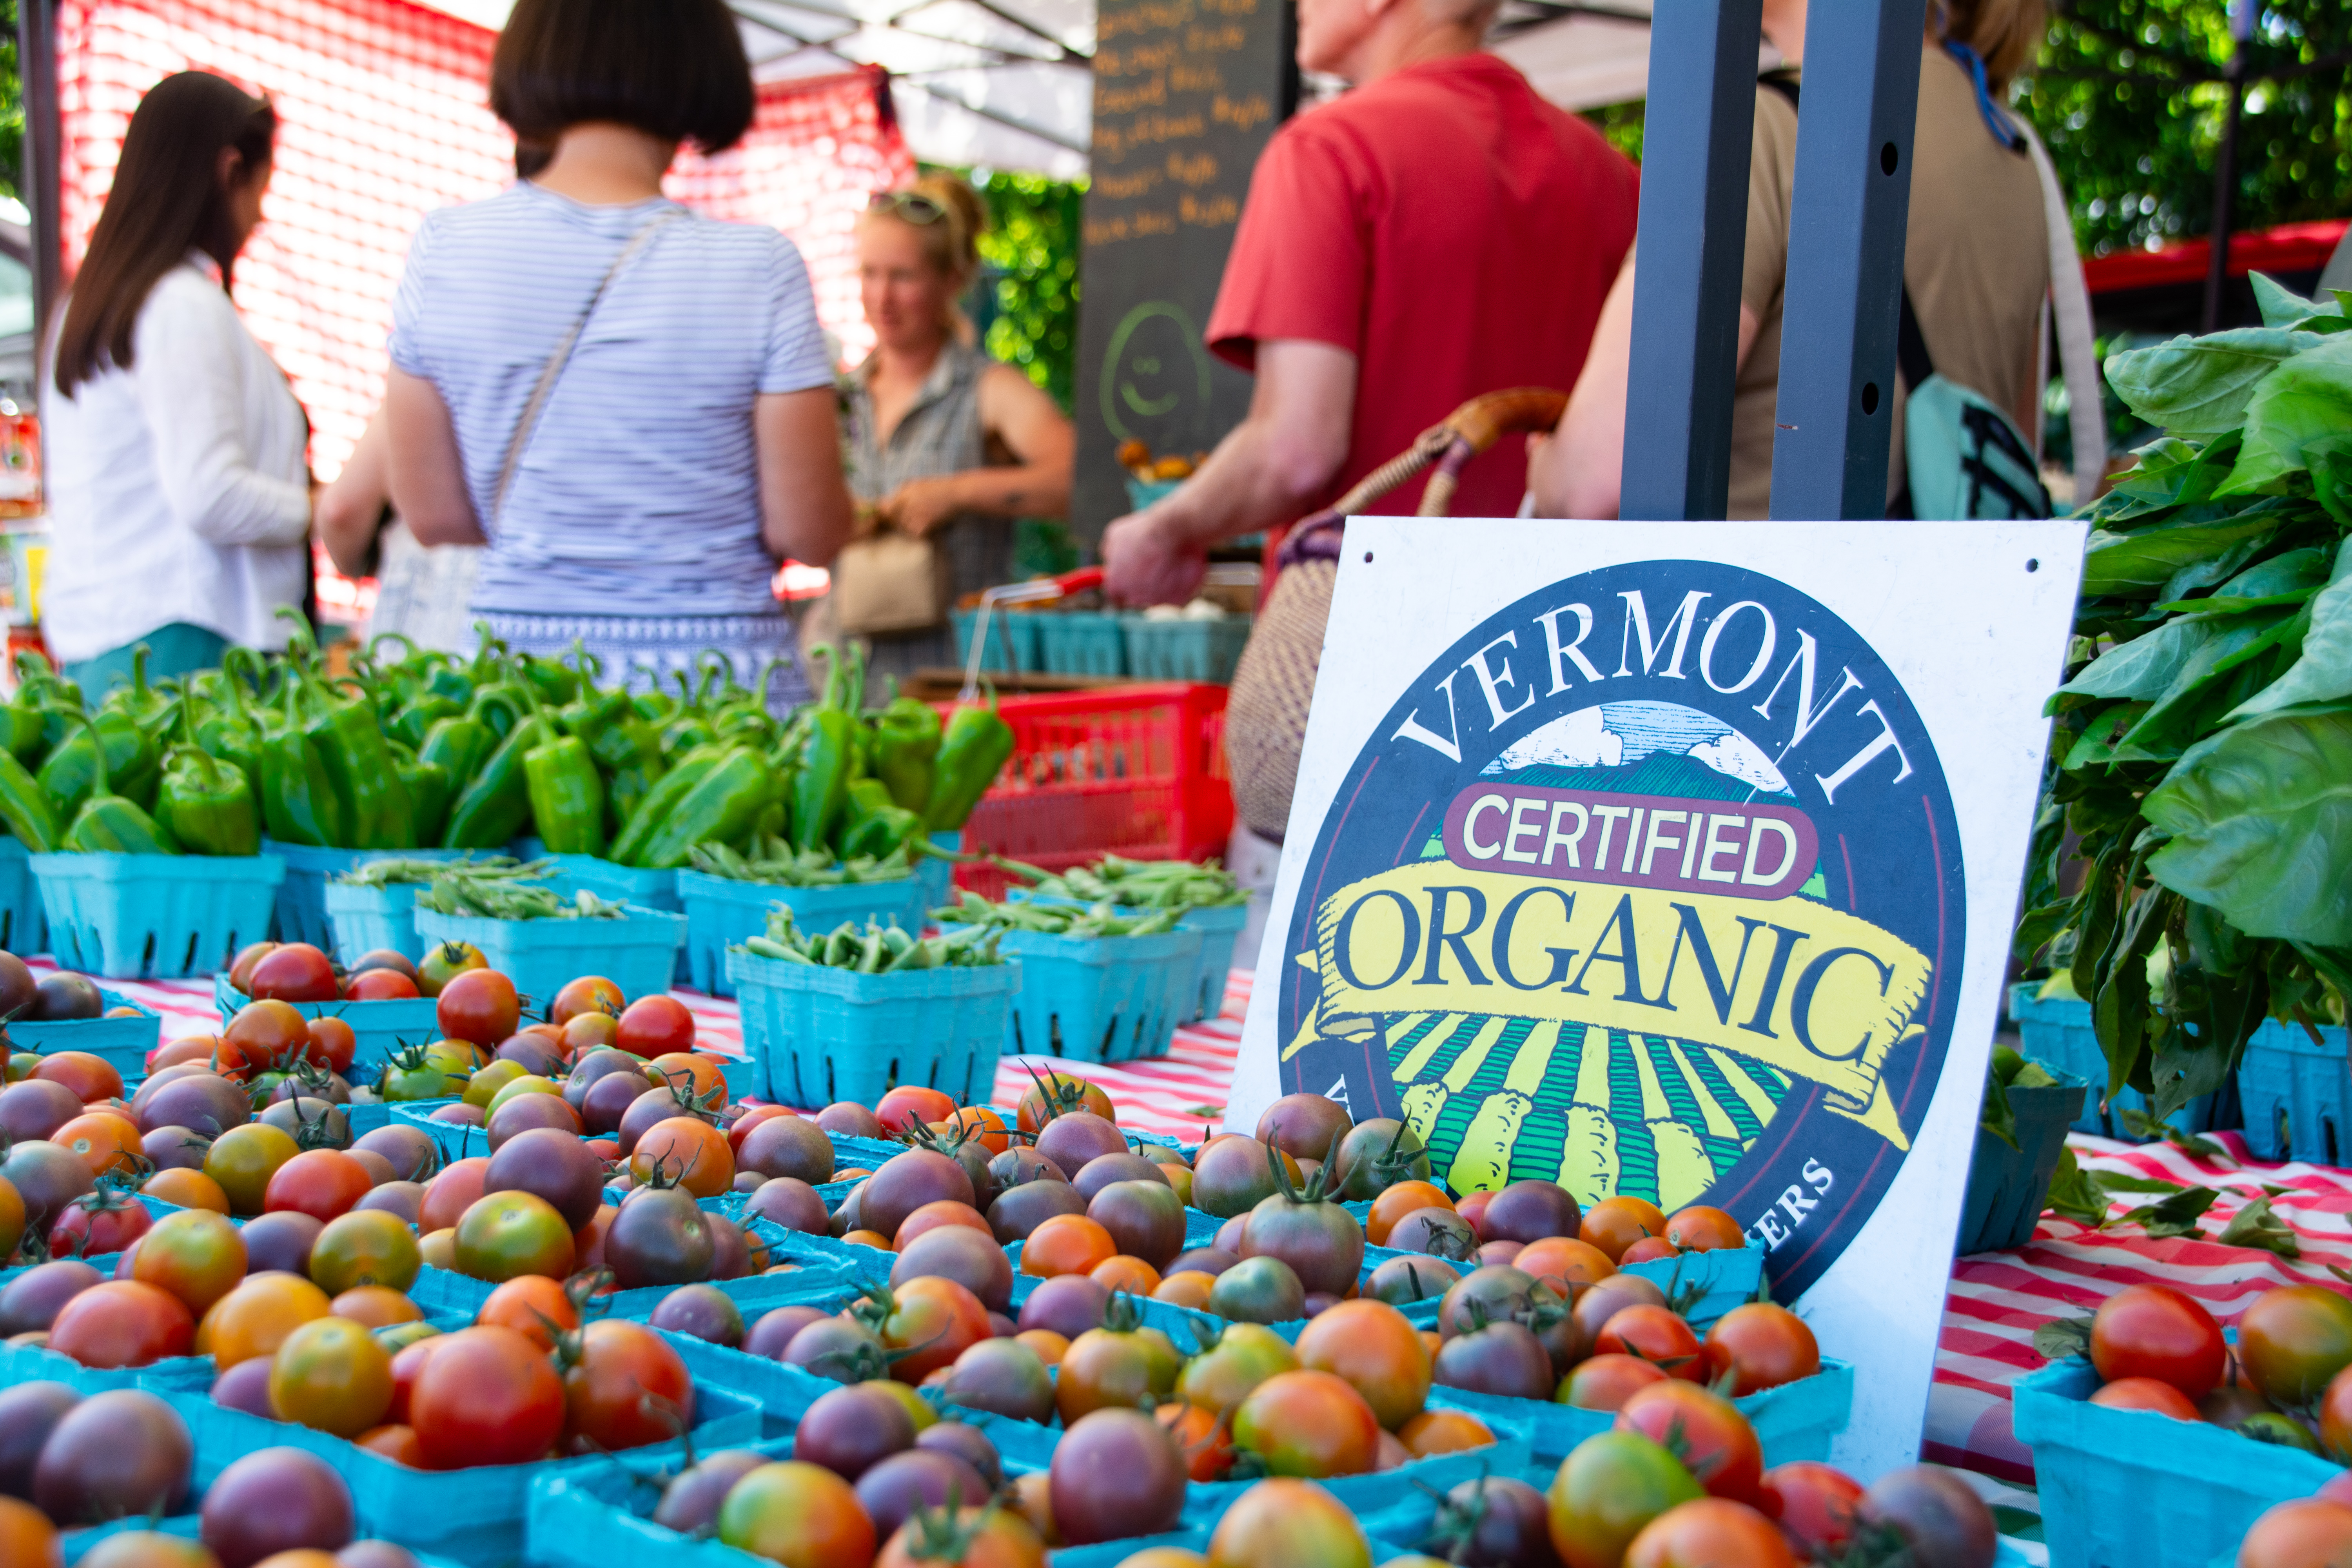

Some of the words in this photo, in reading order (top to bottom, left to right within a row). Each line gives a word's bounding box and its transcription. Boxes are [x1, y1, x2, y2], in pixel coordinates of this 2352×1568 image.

[1390, 590, 1913, 805] VERMONT
[1462, 795, 1797, 887] CERTIFIED
[1334, 886, 1895, 1069] ORGANIC
[1743, 1156, 1833, 1253] ERS
